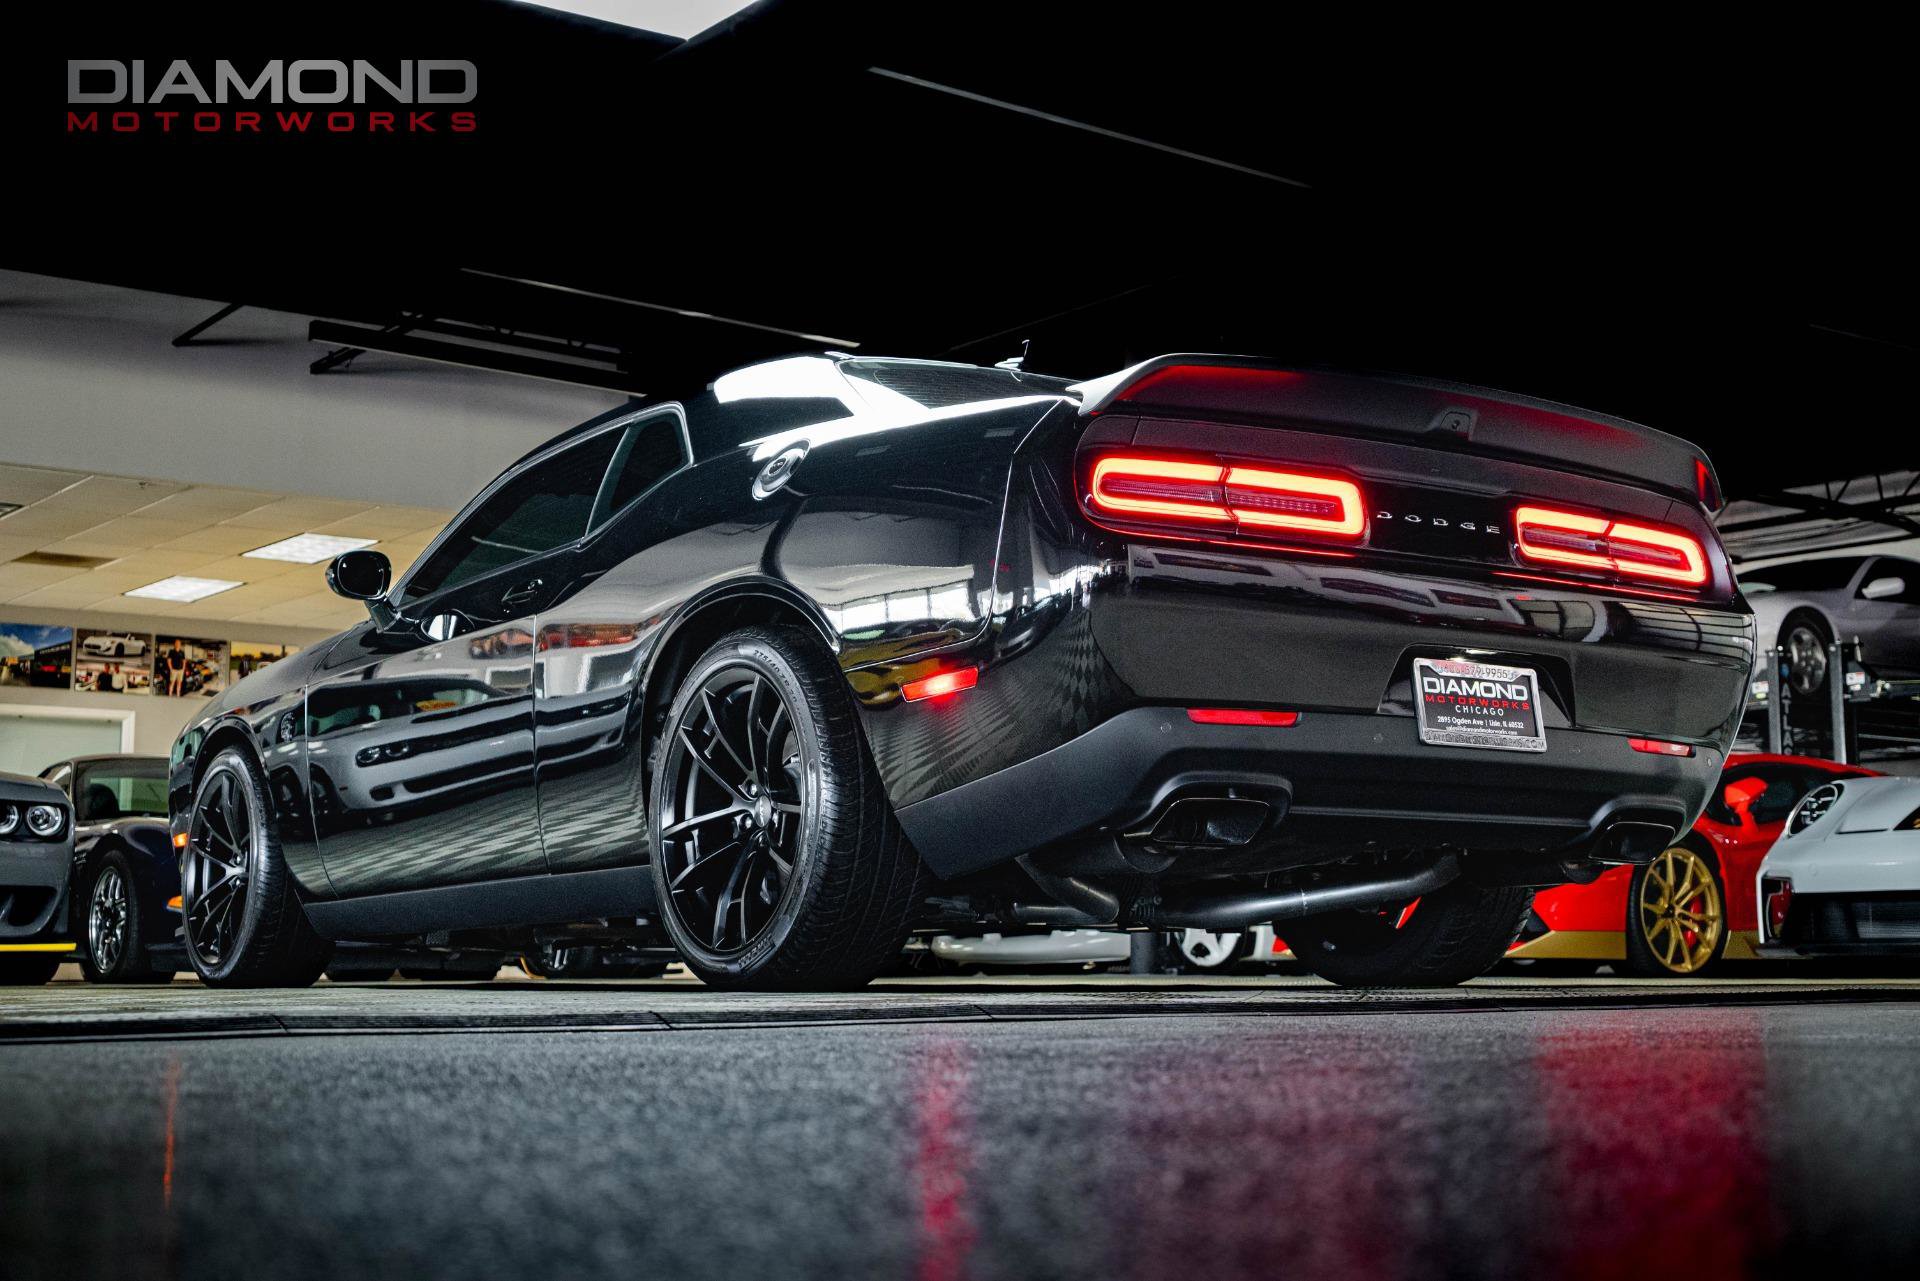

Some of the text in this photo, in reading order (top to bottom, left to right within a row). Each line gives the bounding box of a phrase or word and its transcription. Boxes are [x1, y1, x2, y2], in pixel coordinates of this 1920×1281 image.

[1376, 511, 1501, 534] DODGE
[1423, 677, 1528, 701] DIAMOND
[1425, 695, 1530, 710] MOTORWORKS
[1455, 705, 1504, 717] CHICAGO
[1437, 716, 1451, 724] 2895
[1452, 716, 1472, 727] Ogden
